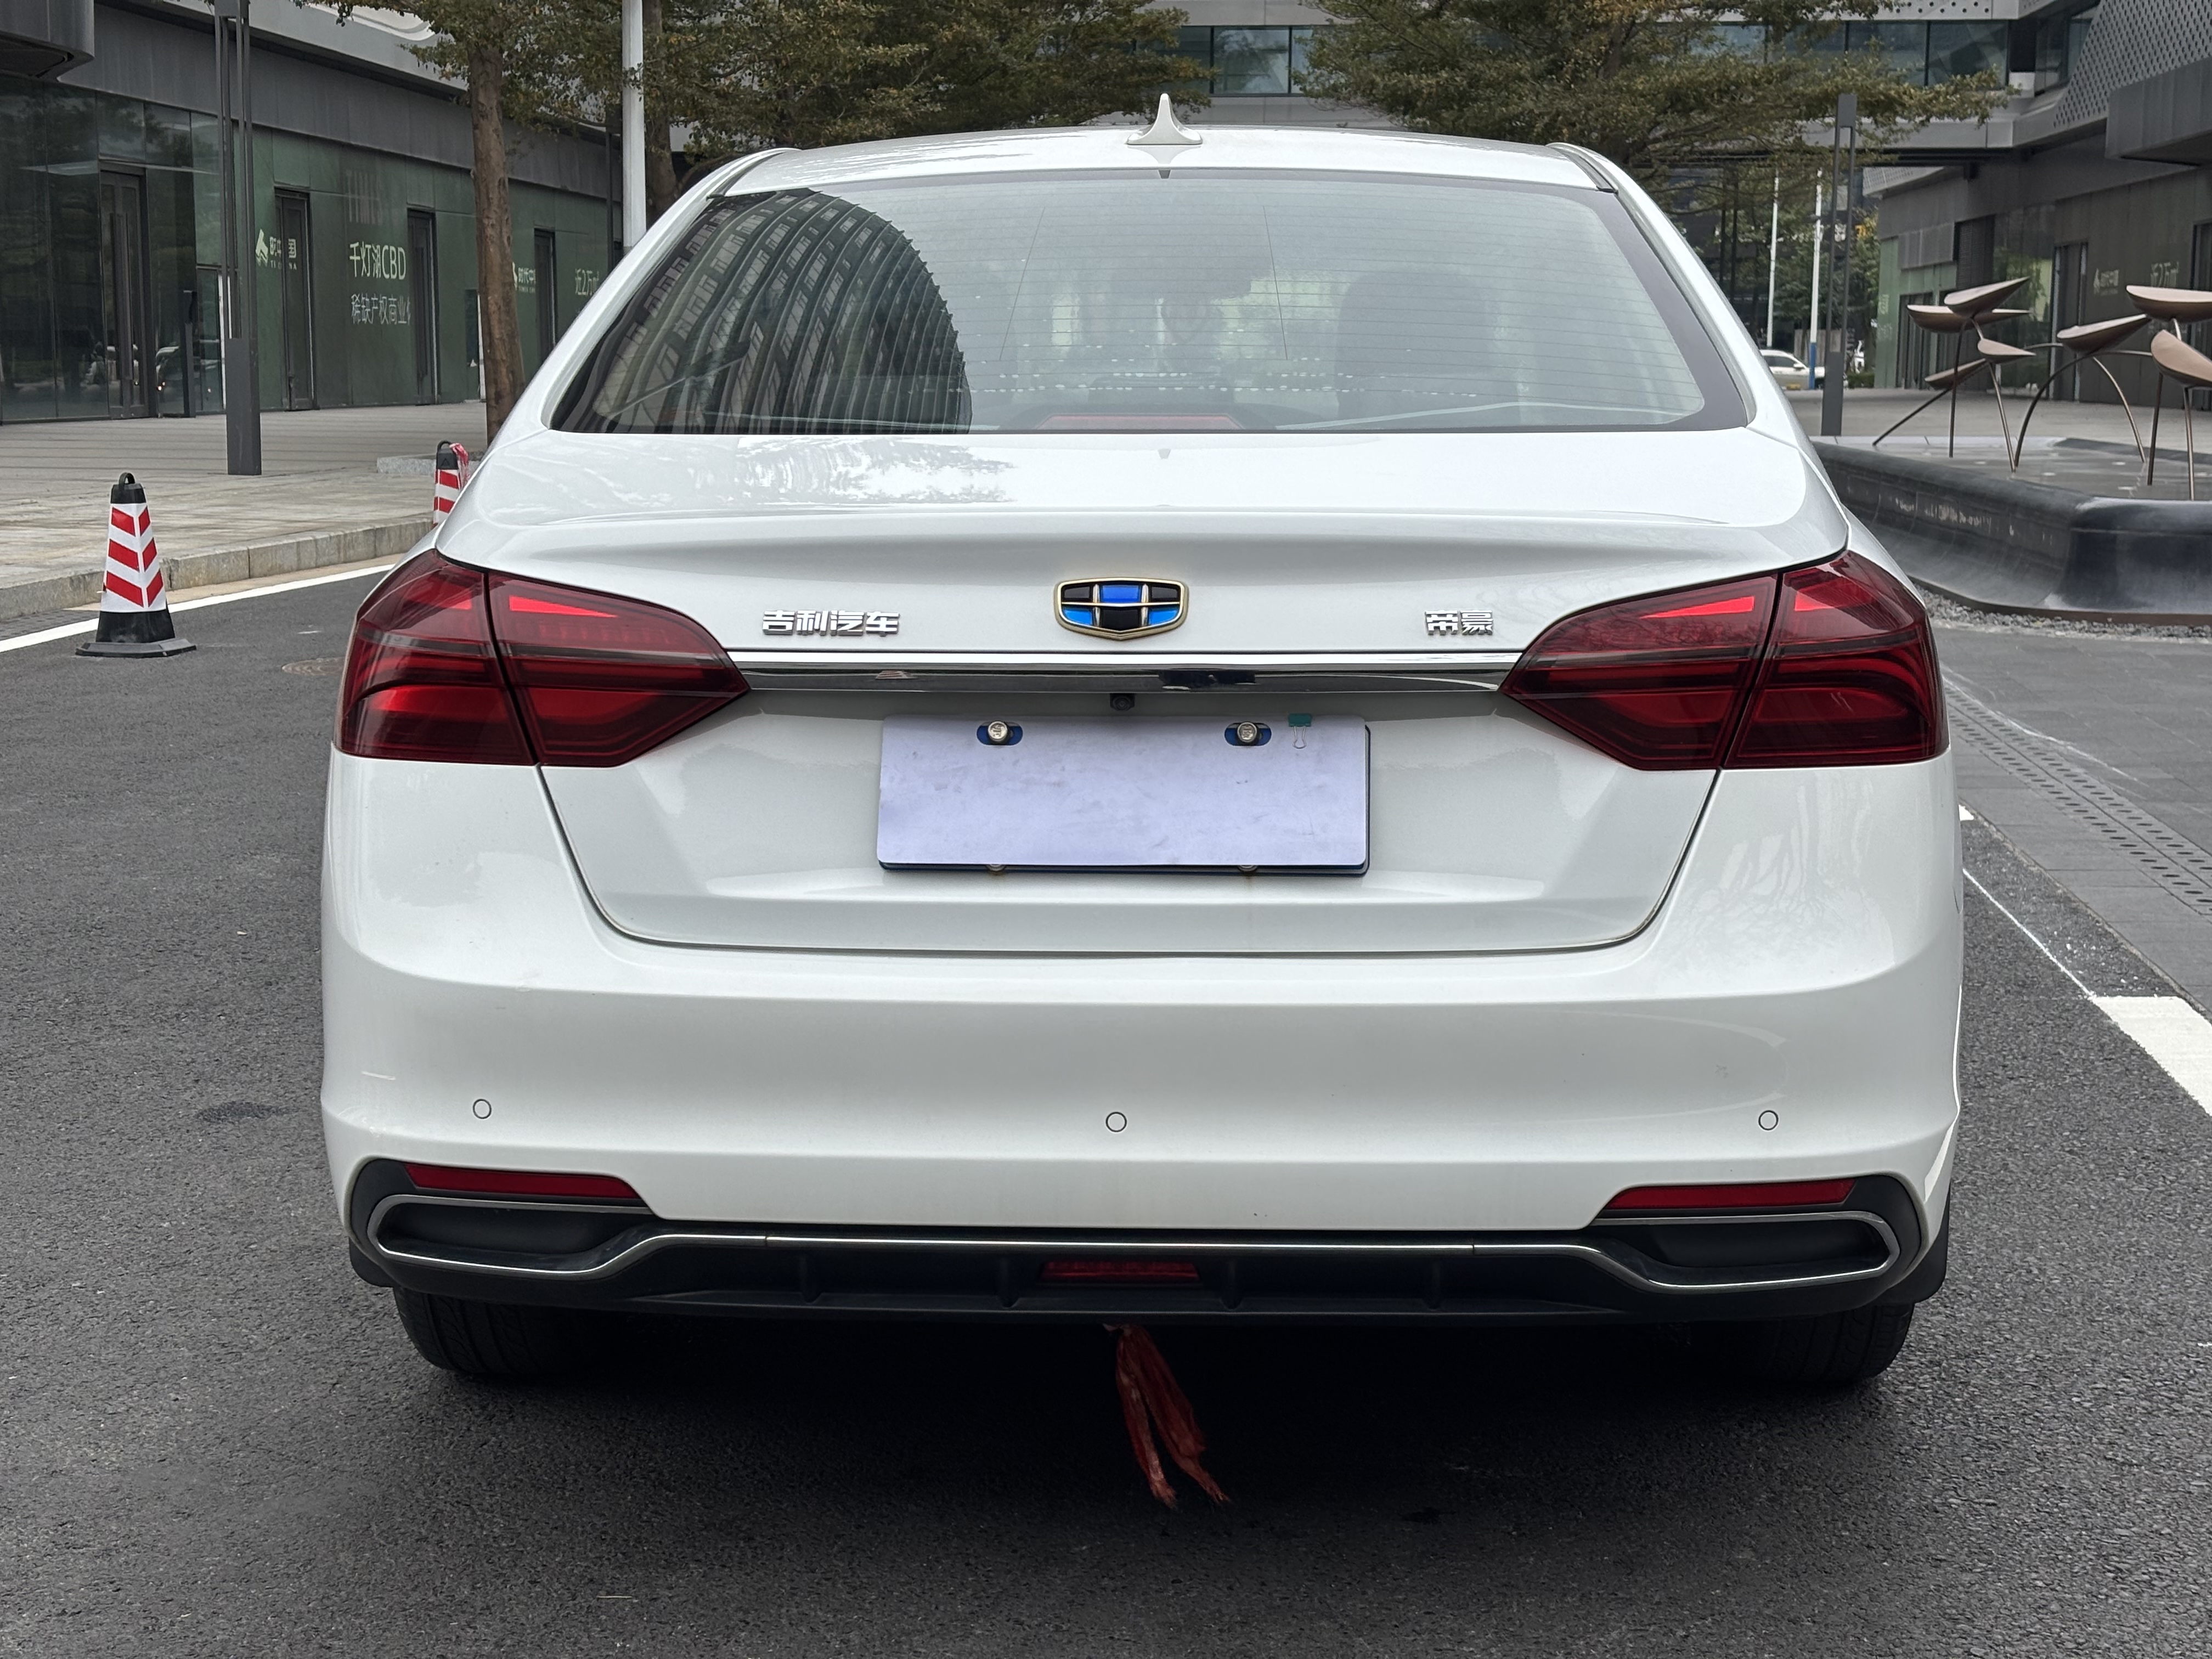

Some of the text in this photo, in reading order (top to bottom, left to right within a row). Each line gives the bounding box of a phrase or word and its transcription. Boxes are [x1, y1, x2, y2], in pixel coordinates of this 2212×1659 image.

[349, 241, 406, 280] 千灯湖CBD
[762, 610, 901, 637] 吉利汽车
[1425, 610, 1493, 636] 帝豪
